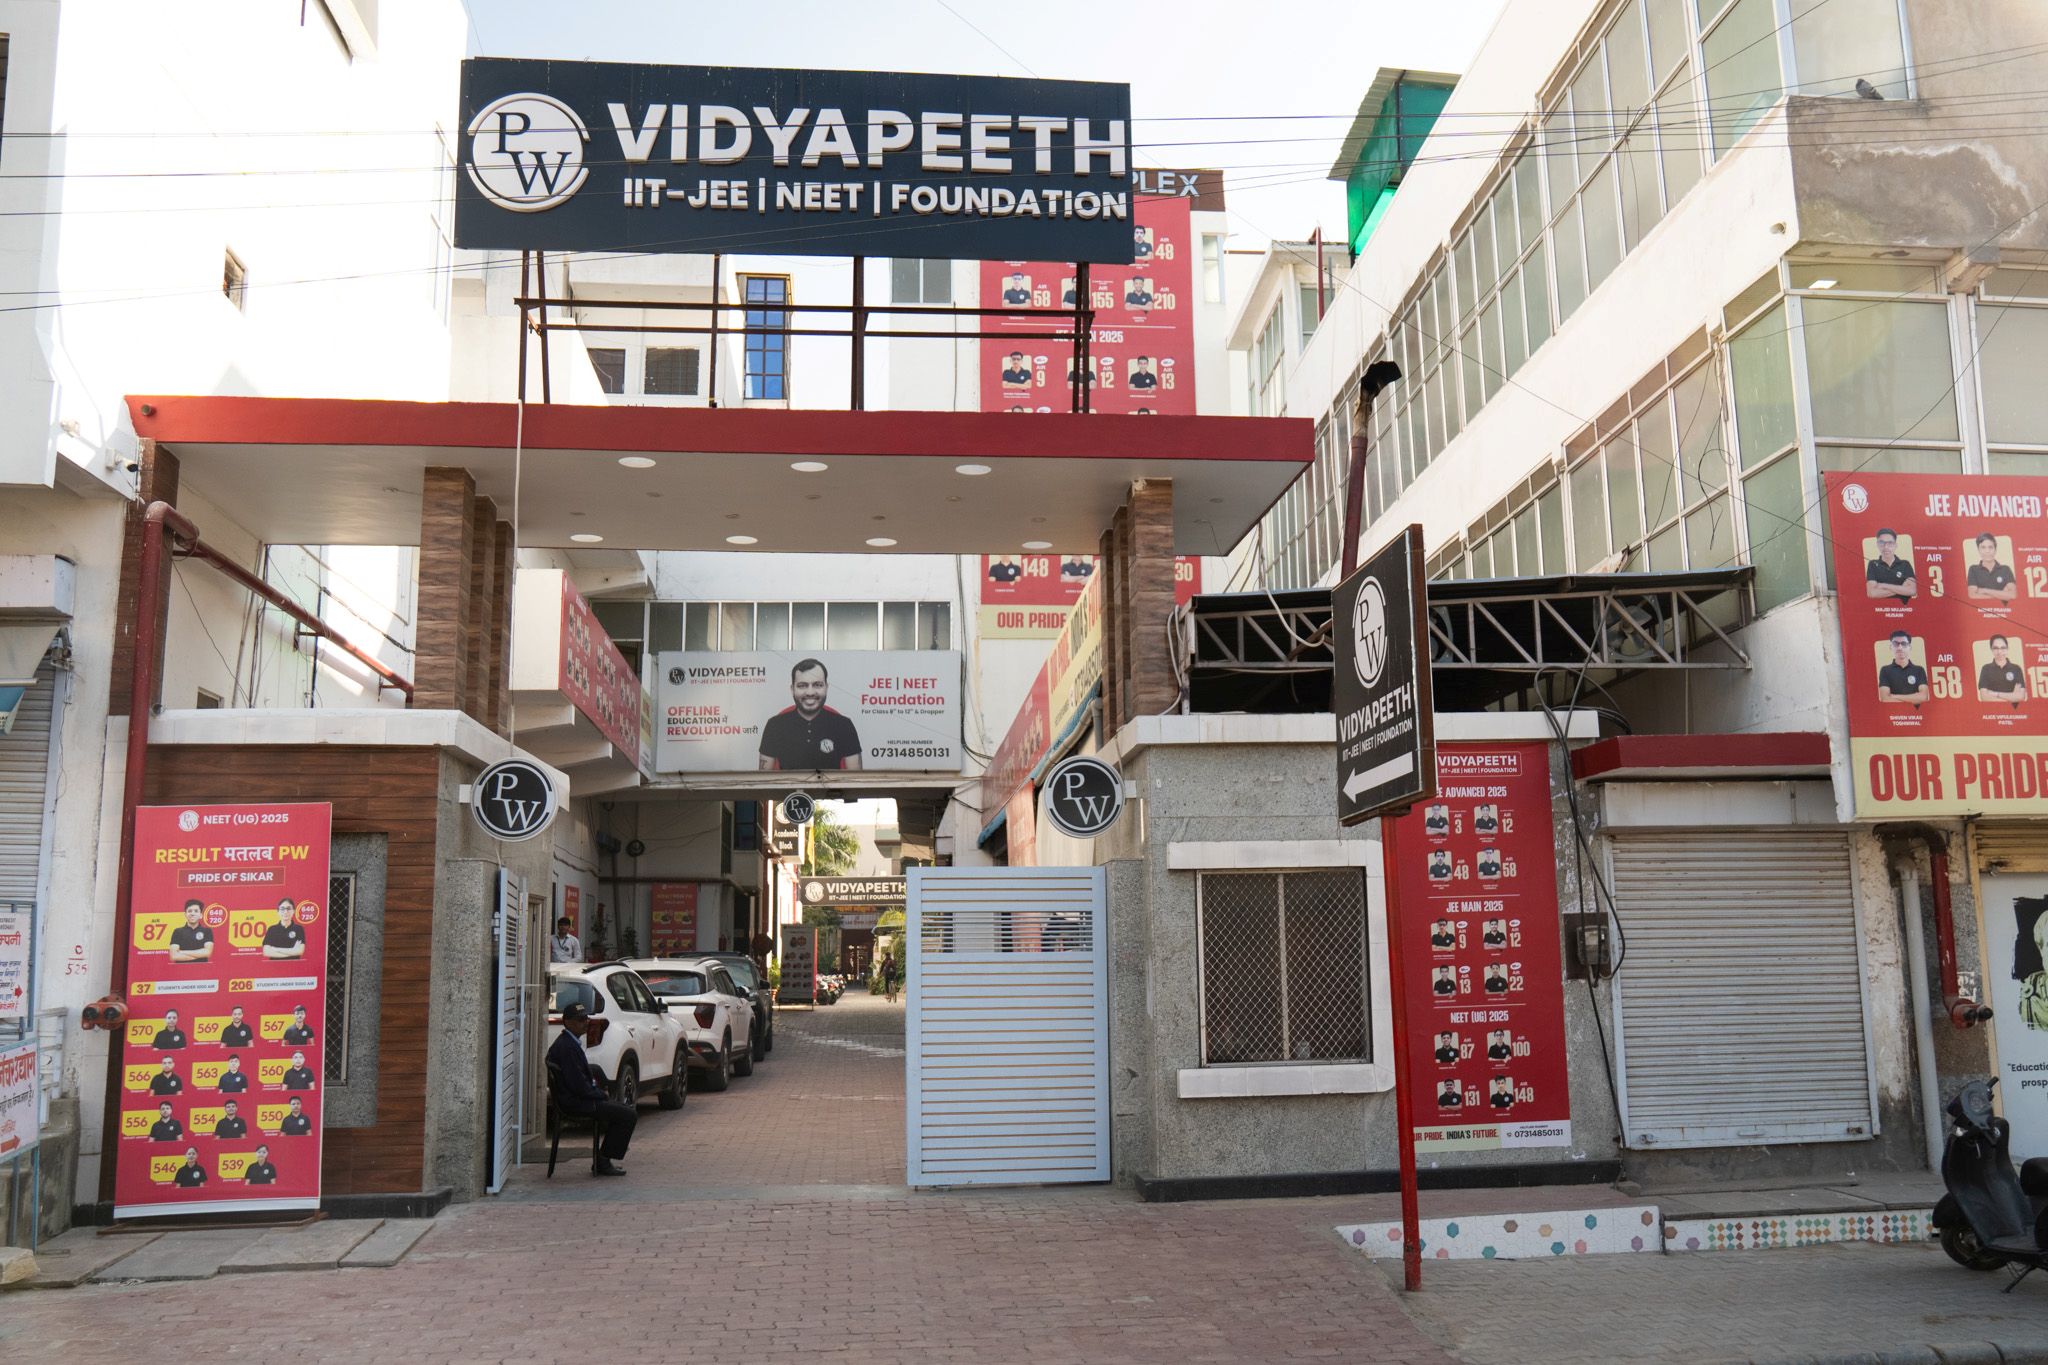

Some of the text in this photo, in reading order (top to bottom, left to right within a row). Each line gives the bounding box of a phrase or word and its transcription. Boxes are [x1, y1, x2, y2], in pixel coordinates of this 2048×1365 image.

[607, 103, 1126, 177] VIDYAPEETH
[491, 112, 573, 195] PW
[624, 178, 1126, 219] IIT-JEE NEET FOUNDATION
[1155, 244, 1174, 260] 48
[1033, 290, 1176, 310] 58 155 210
[1099, 331, 1123, 343] 2025
[1036, 372, 1175, 389] 9 12 13
[1925, 494, 1951, 517] JEE
[1957, 495, 2041, 518] ADVANCED
[1926, 554, 2042, 563] AIR AIR
[1022, 558, 1048, 577] 148
[1928, 566, 2048, 598] 3 12
[997, 612, 1024, 628] OUR
[1359, 599, 1382, 674] PW
[1937, 654, 1953, 662] AIR
[689, 667, 766, 677] VIDYAPEETH
[868, 678, 937, 689] JEE NEET
[1931, 666, 1963, 698] 58
[861, 694, 945, 705] Foundation
[668, 706, 720, 717] OFFLINE
[1339, 682, 1412, 743] VIDYAPEETH
[667, 726, 741, 736] REVOLUTION
[1342, 717, 1413, 762] IIT-JEE NEET FOUNDATION
[871, 747, 949, 758] 07314850131
[1438, 756, 1517, 766] VIDYAPEETH
[1869, 754, 1943, 801] OUR
[1063, 773, 1110, 825] PW
[1445, 787, 1485, 798] ADVANCED
[1487, 786, 1507, 797] 2025
[491, 773, 541, 829] PW
[791, 799, 809, 819] PW
[203, 815, 231, 825] NEET
[233, 814, 259, 825] (UG)
[261, 813, 289, 823] 2025
[1455, 818, 1513, 834] 3 12
[774, 829, 798, 837] Academic
[779, 841, 793, 849] Block
[155, 845, 309, 863] RESULT मतलब PW
[188, 871, 273, 883] PRIDE OF SIKAR
[1454, 862, 1517, 880] 48 58
[826, 882, 906, 893] VIDYAPEETH
[1447, 900, 1503, 913] JEE MAIN 2025
[143, 921, 267, 941] 87 100
[1459, 932, 1521, 949] 9 12
[136, 983, 151, 994] 37
[231, 980, 253, 991] 206
[1459, 975, 1524, 994] 13 22
[1450, 1010, 1509, 1023] NEET (UG) 2025
[131, 1020, 285, 1036] 570 569 567
[1461, 1041, 1530, 1059] 87 100
[128, 1065, 284, 1082] 566 563 560
[1464, 1087, 1534, 1106] 131 148
[125, 1111, 283, 1128] 556 554 550
[1446, 1130, 1471, 1140] INDIA'S
[1514, 1129, 1563, 1138] 07314850131
[153, 1160, 244, 1174] 546 539
